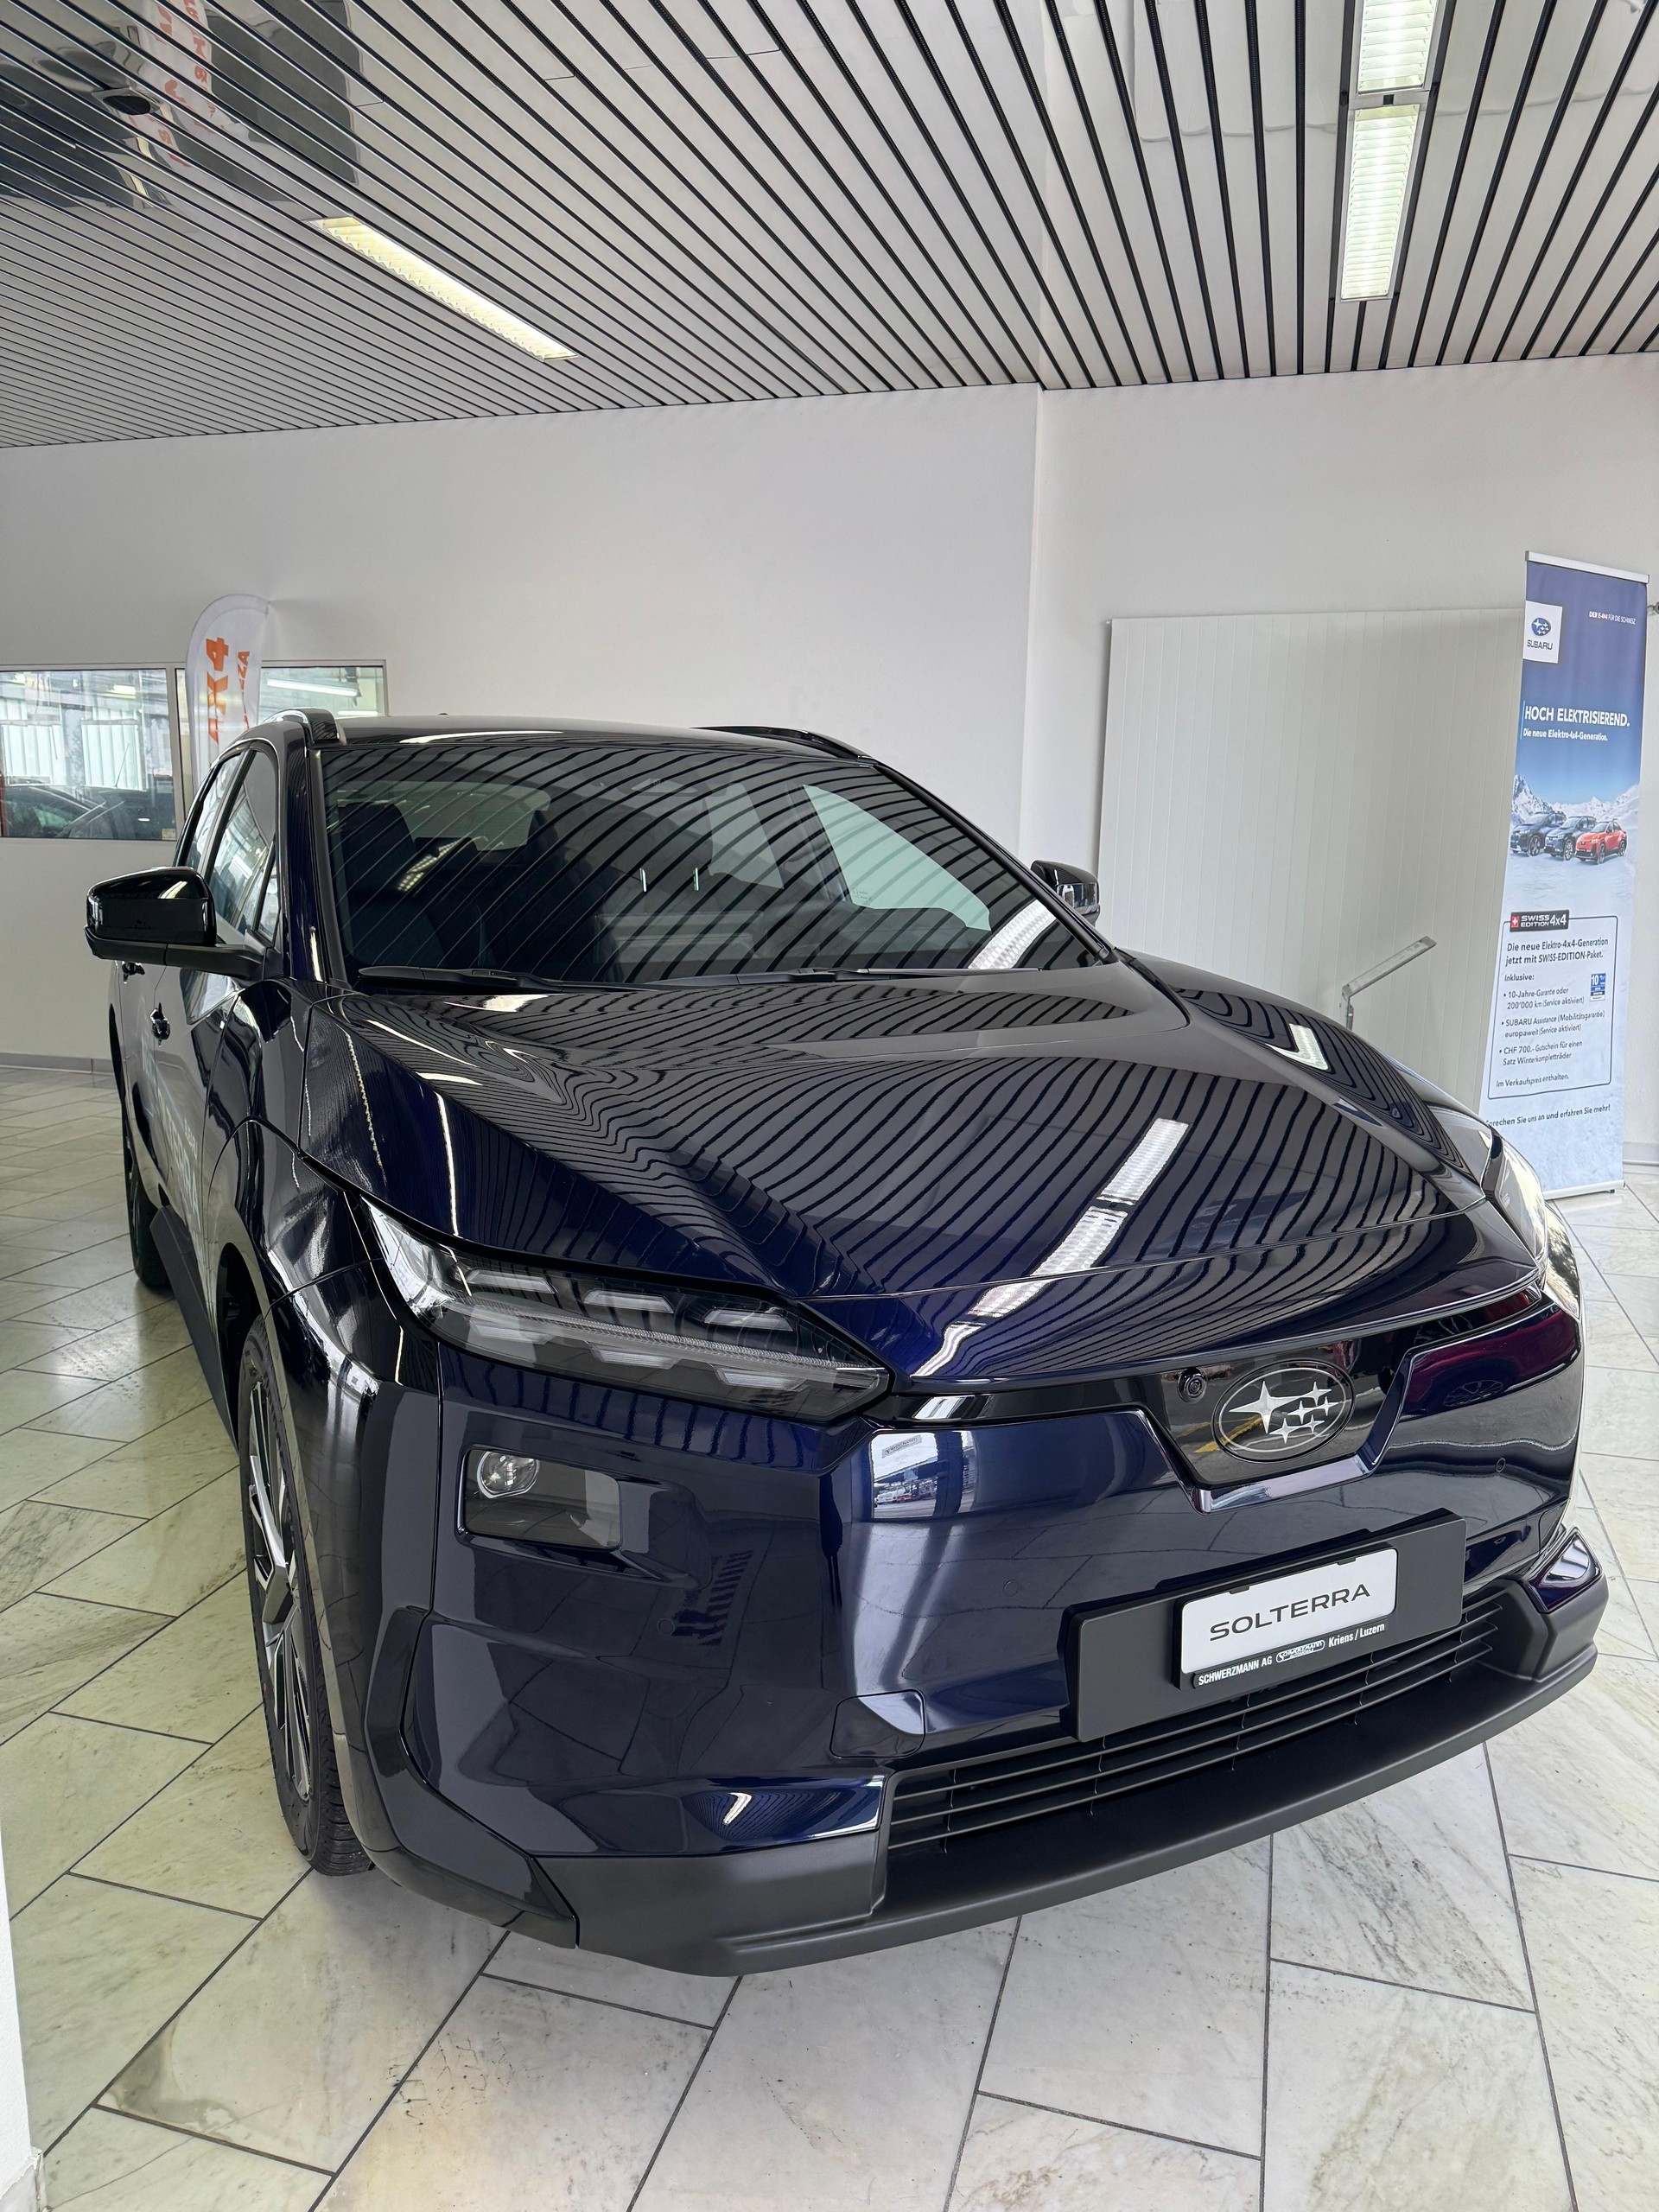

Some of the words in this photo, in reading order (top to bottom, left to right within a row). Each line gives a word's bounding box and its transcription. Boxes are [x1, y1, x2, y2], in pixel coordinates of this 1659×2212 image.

[1527, 639, 1554, 650] SUBARU
[1525, 705, 1554, 721] HOCH
[1557, 708, 1630, 727] ELEKTRISIEREND.
[1523, 728, 1532, 737] Die
[1549, 913, 1567, 926] 4x4
[1507, 943, 1519, 951] Die
[1541, 937, 1609, 950] Elektro-4x4-Generation
[1505, 955, 1522, 967] jetzt
[1524, 954, 1537, 963] mit
[1538, 950, 1604, 963] SWISS-EDITION-Paket.
[1504, 973, 1535, 982] Inklusive:
[1508, 988, 1555, 999] 10-Jahre-Garantie
[1542, 998, 1560, 1008] (Service
[1561, 996, 1585, 1006] aktiviert)
[1505, 1018, 1532, 1027] SUBARU
[1533, 1016, 1557, 1025] Assistance
[1504, 1028, 1539, 1039] europaweit
[1539, 1026, 1557, 1035] (Service
[1558, 1023, 1582, 1033] aktiviert)
[1503, 1046, 1517, 1054] CHF
[1560, 1040, 1568, 1049] für
[1503, 1058, 1516, 1066] Satz
[1504, 1076, 1542, 1087] Verkaufspreis
[1541, 1072, 1569, 1083] enthalten.
[1516, 1116, 1527, 1124] Sie
[1546, 1111, 1559, 1120] und
[1560, 1108, 1583, 1118] erfahren
[1593, 1103, 1611, 1113] mehr!
[1210, 1583, 1371, 1642] SOLTERRA
[1198, 1660, 1259, 1686] SCHWERZMANN
[1261, 1656, 1273, 1669] AG
[1328, 1631, 1354, 1648] Kriens
[1360, 1623, 1385, 1638] Luzern
